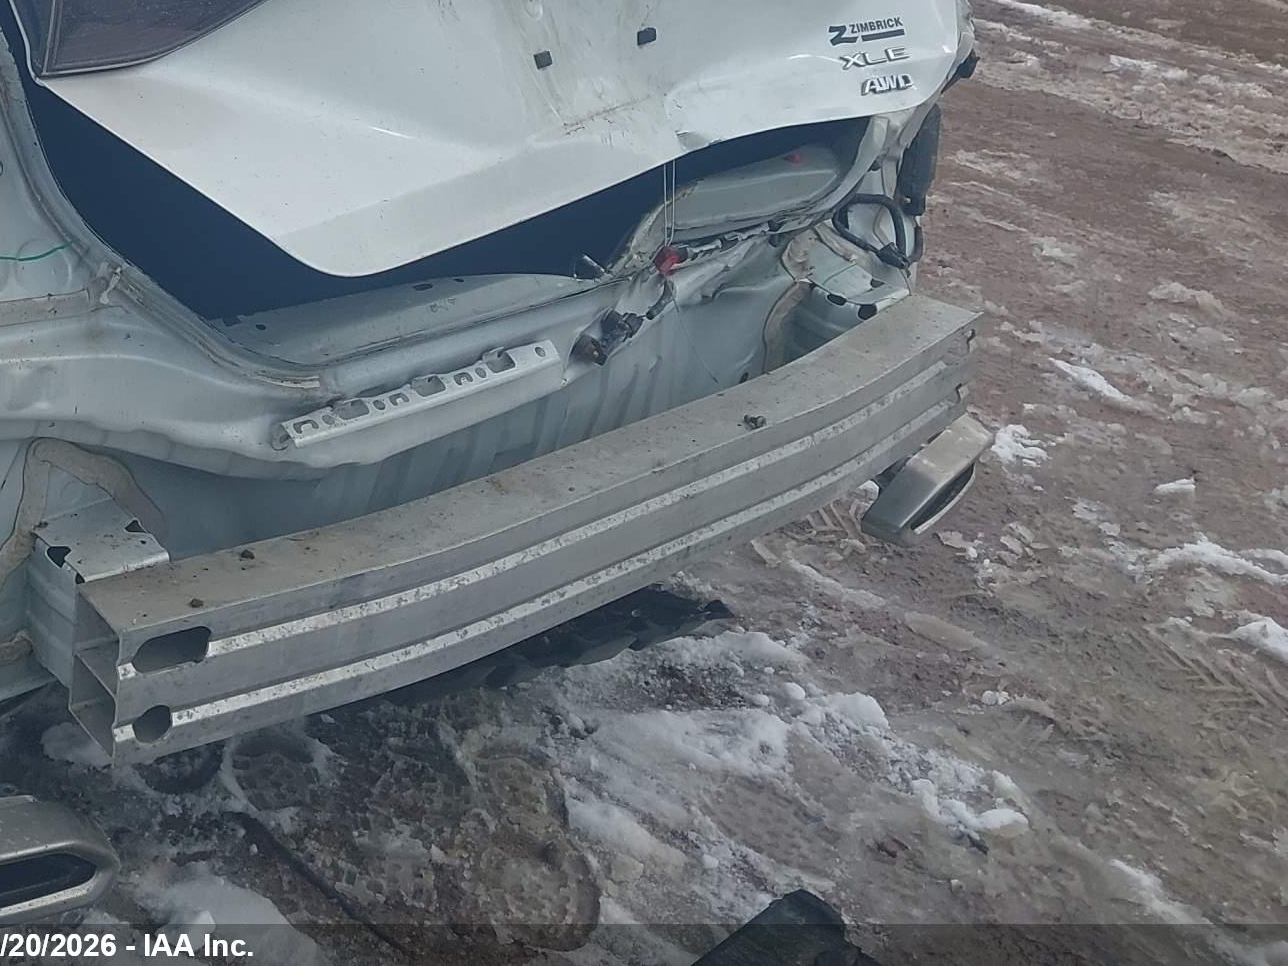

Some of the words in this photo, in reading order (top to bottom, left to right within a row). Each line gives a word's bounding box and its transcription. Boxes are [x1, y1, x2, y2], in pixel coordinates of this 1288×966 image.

[848, 17, 904, 34] ZIMBRICK
[839, 47, 911, 70] XLE
[860, 74, 916, 96] AWD
